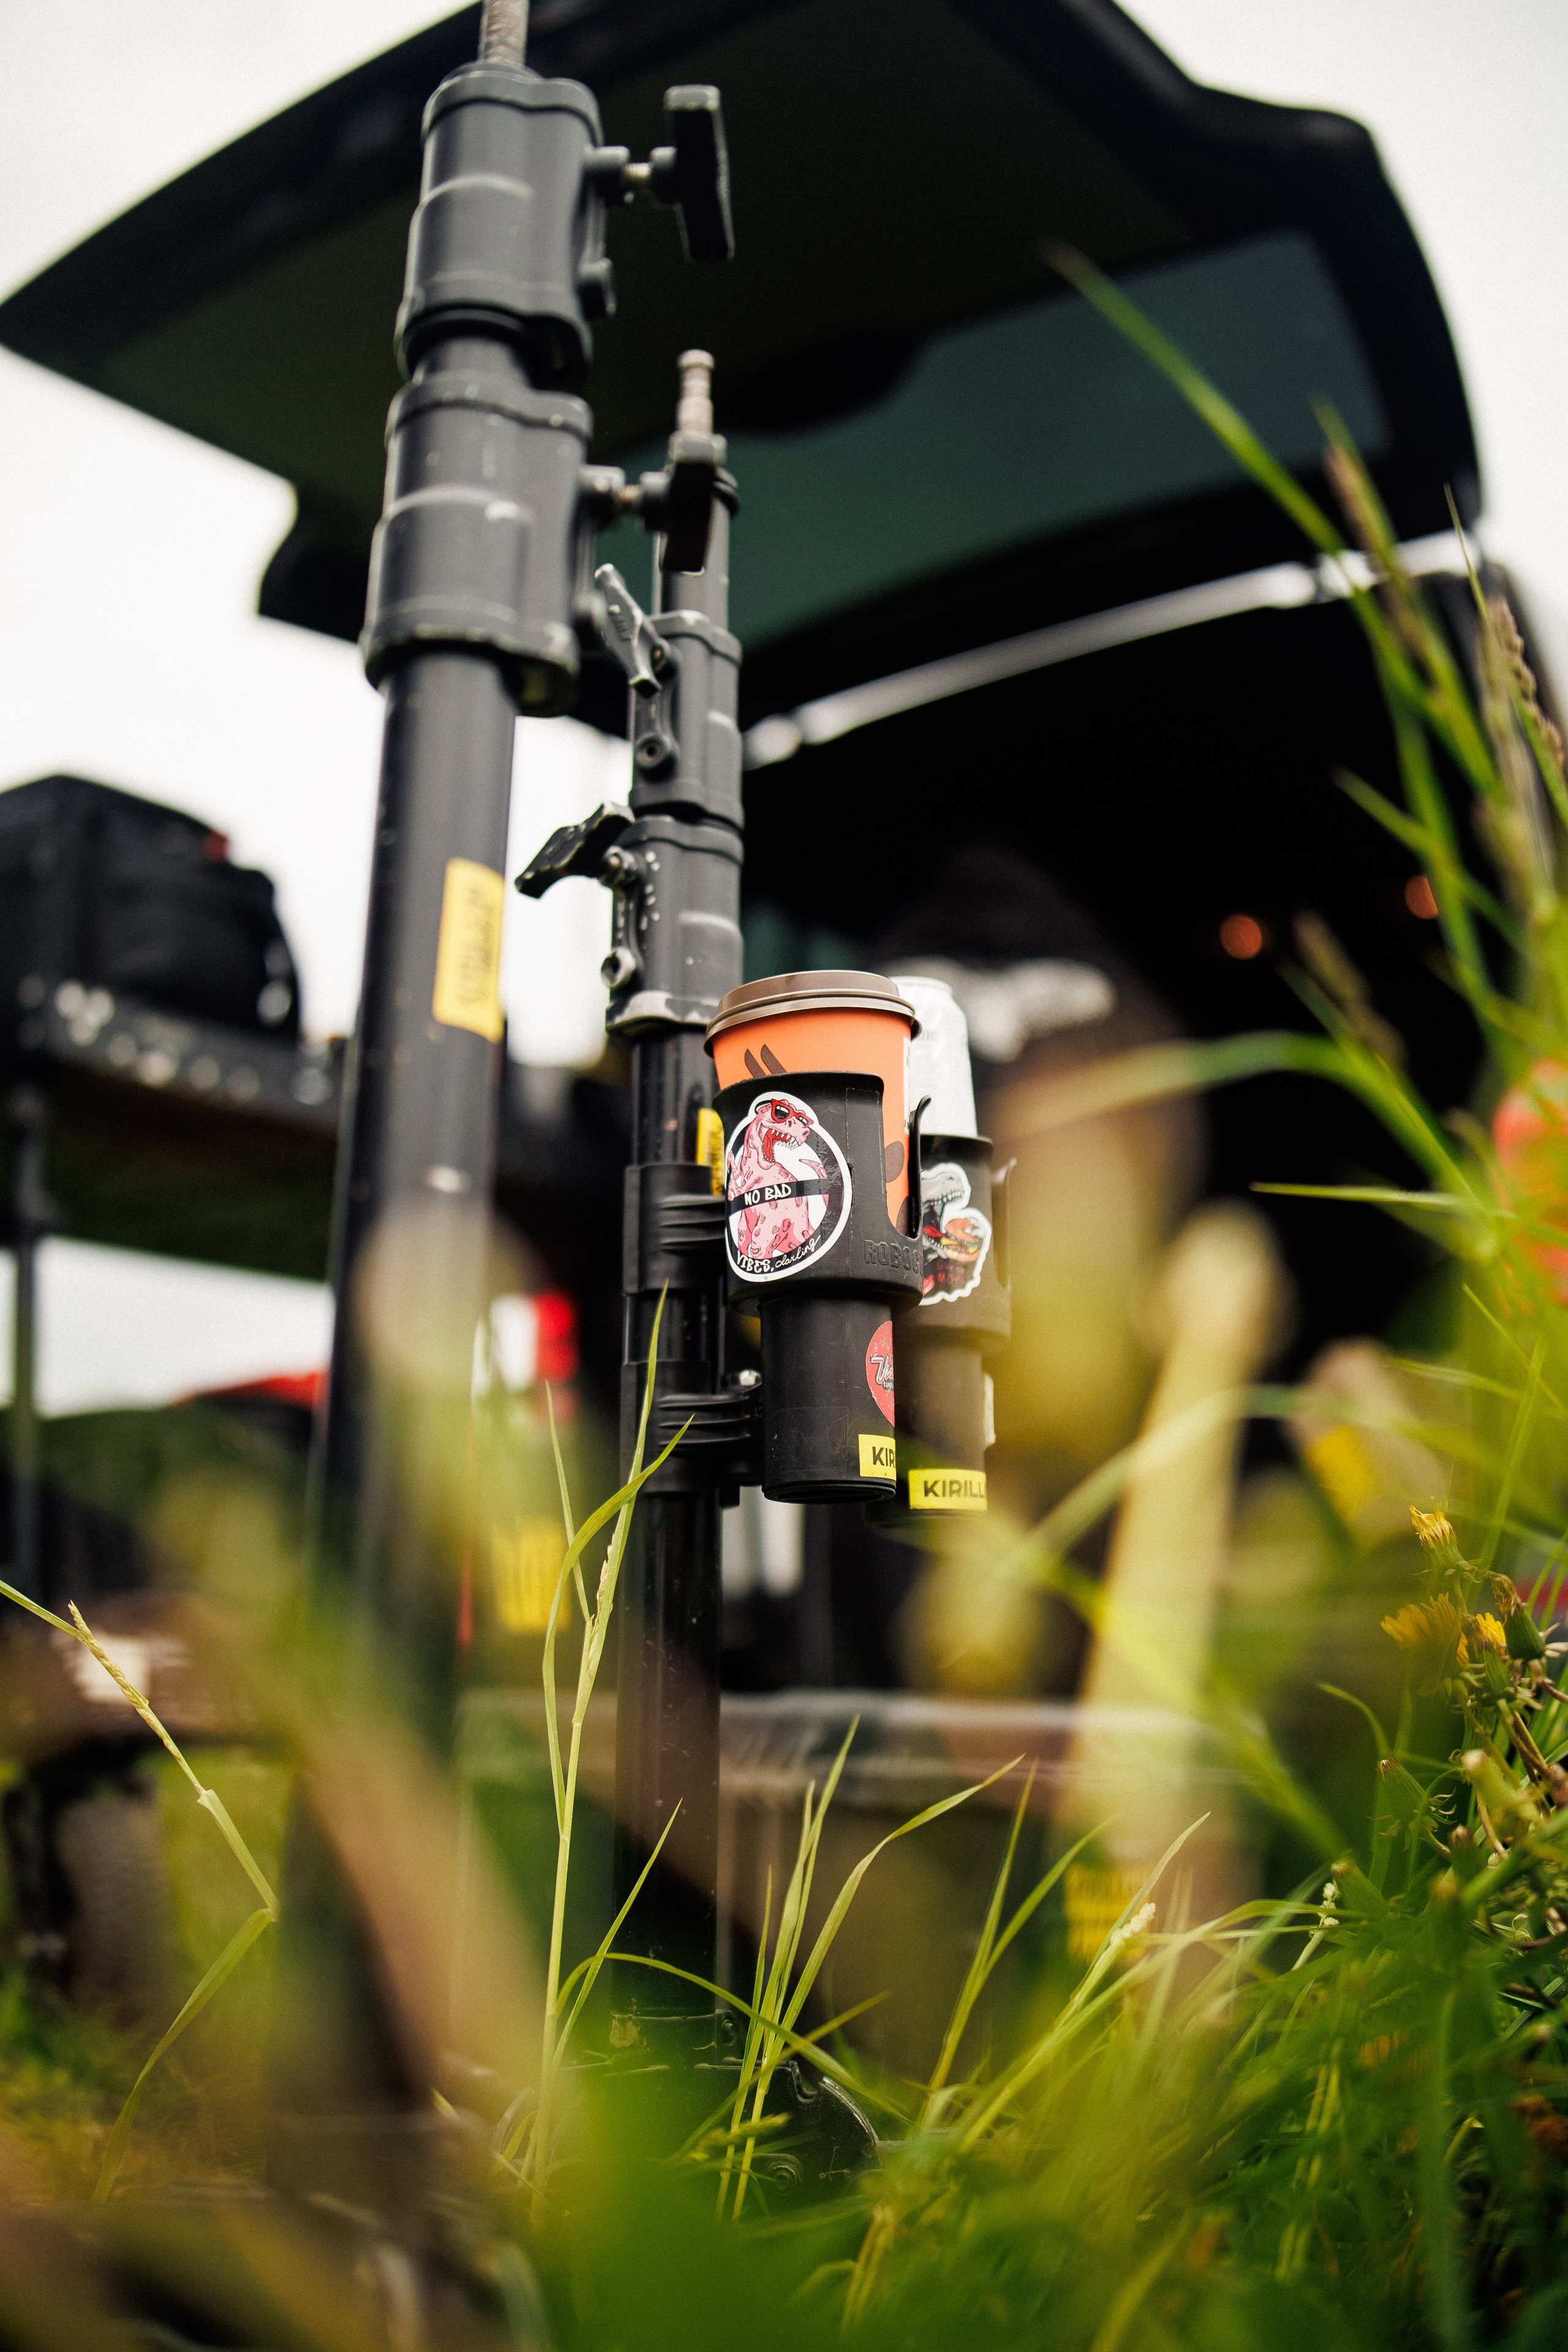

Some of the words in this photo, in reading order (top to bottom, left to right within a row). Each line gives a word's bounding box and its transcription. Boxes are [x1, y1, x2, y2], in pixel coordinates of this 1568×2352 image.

[744, 1189, 760, 1205] NO
[765, 1183, 791, 1200] BAD
[737, 1250, 774, 1273] VIBES,
[775, 1235, 821, 1268] darling
